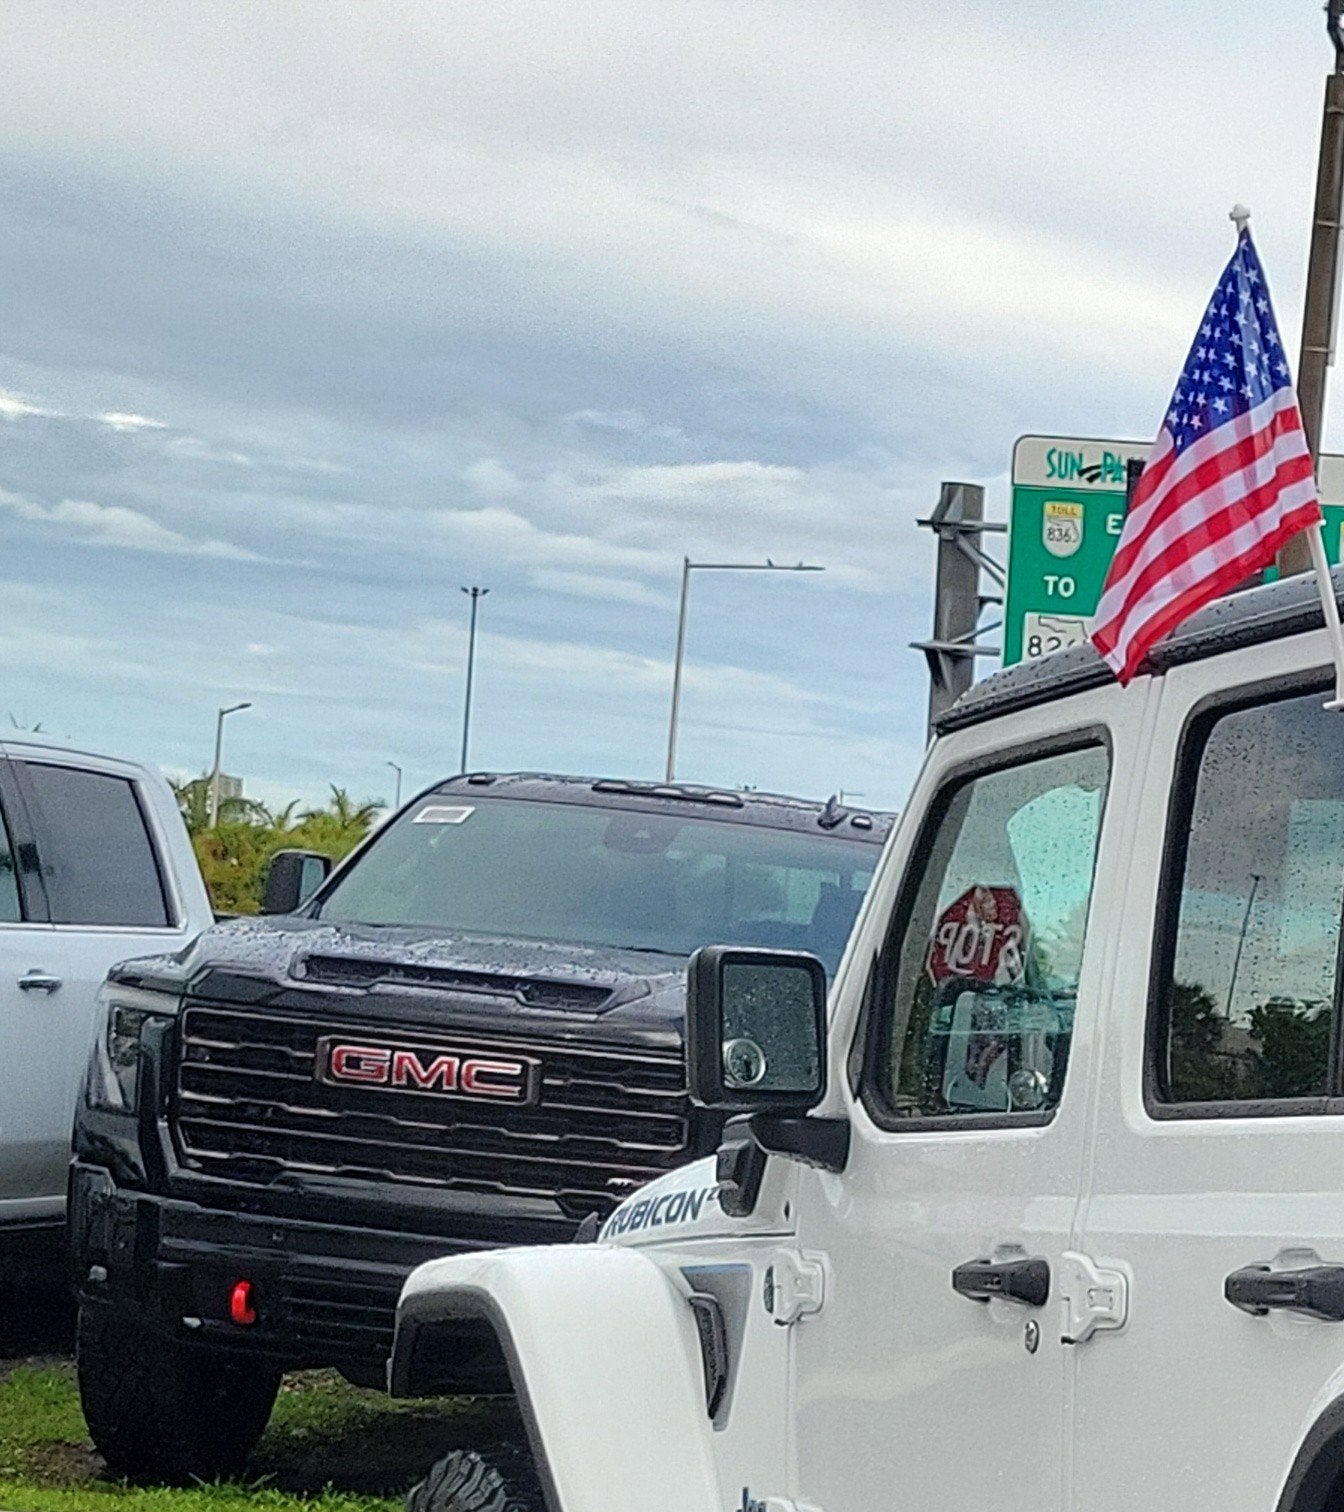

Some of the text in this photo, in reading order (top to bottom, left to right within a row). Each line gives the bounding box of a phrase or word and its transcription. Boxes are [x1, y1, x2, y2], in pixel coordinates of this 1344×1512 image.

[1045, 448, 1083, 480] SUN
[1051, 504, 1078, 516] TOLL
[1047, 527, 1073, 543] 836
[1043, 575, 1076, 598] TO
[331, 1044, 523, 1097] GMC
[603, 1187, 708, 1239] RUBICON
